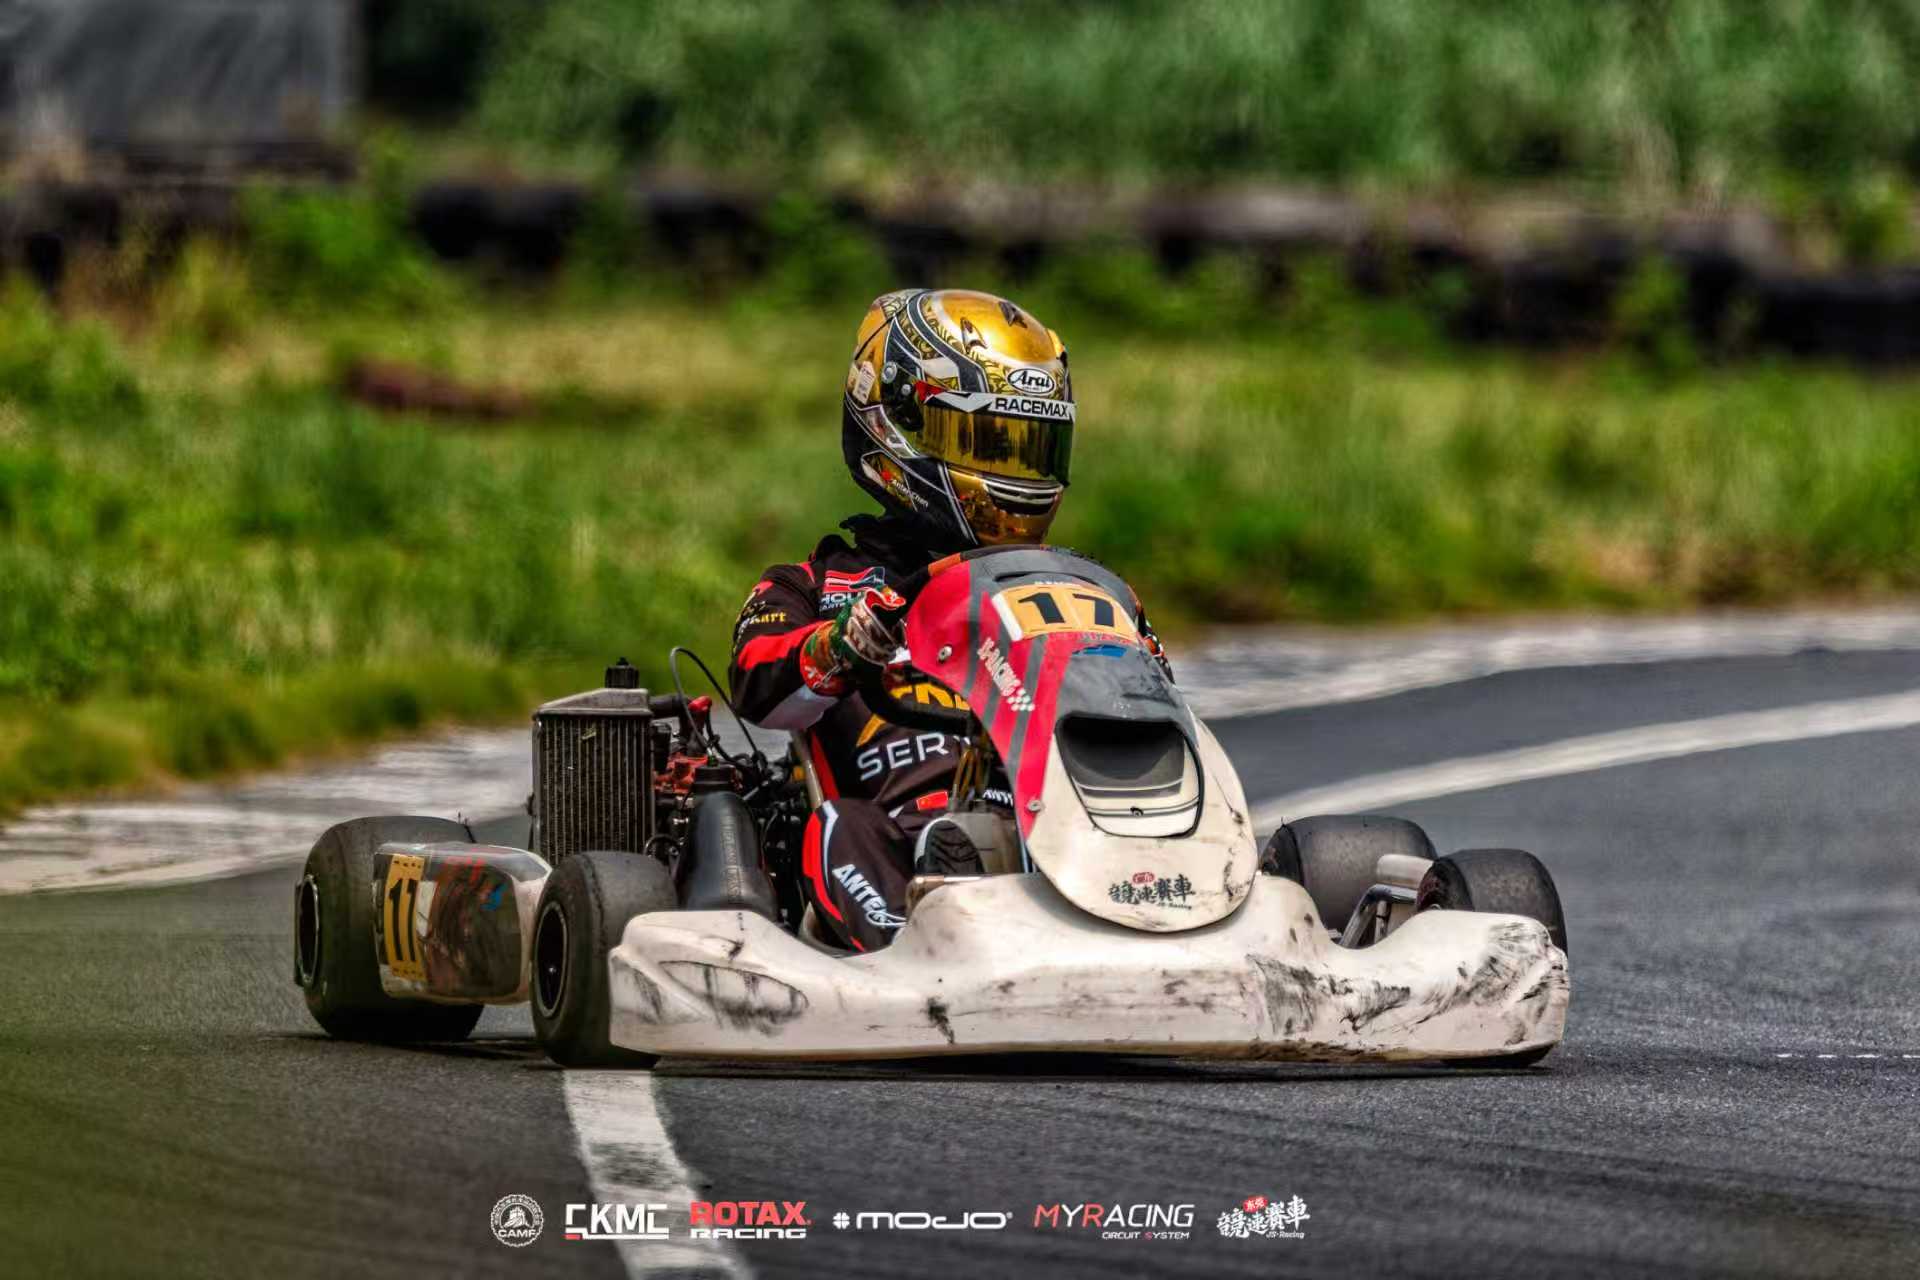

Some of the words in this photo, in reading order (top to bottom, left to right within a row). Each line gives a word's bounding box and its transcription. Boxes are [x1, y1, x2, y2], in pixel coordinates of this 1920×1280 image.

[1010, 370, 1050, 388] Arai
[995, 397, 1068, 417] RACEMAX
[858, 733, 971, 780] SER
